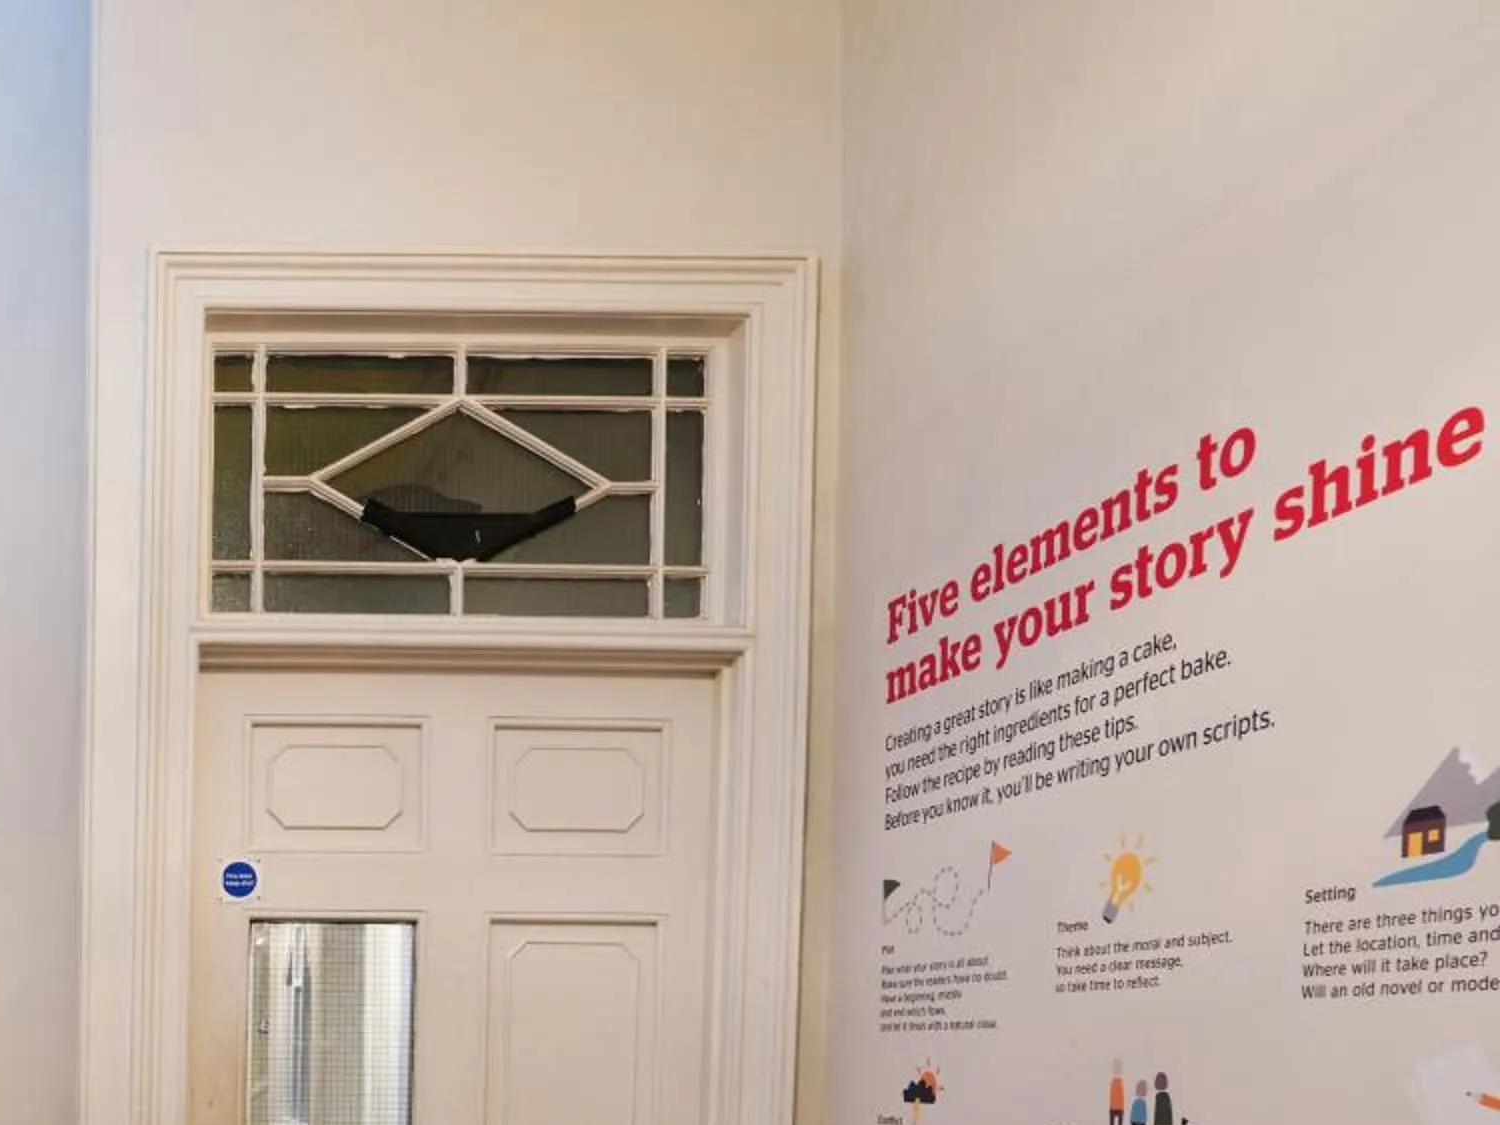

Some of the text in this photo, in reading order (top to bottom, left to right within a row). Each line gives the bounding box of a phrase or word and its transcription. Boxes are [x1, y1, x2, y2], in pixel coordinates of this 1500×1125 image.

[886, 426, 1256, 644] Five elements to
[885, 405, 1485, 704] make your story shine
[885, 633, 1177, 752] Creating a great story is like making a cake,
[885, 650, 1231, 780] you need the right ingredients for a perfect bake.
[885, 714, 1138, 804] Follow the recipe by reading these tips.
[885, 811, 920, 831] Before
[922, 804, 943, 824] you
[946, 794, 978, 813] know
[997, 774, 1033, 805] you'll
[1035, 772, 1053, 790] be
[1057, 756, 1110, 784] writing
[1115, 743, 1154, 772] your
[1158, 731, 1197, 757] own
[1203, 709, 1275, 745] scripts.
[1305, 886, 1356, 904] Setting
[1057, 921, 1089, 933] Theme
[1304, 919, 1343, 935] There
[1348, 918, 1371, 931] are
[1376, 912, 1417, 928] three
[1422, 906, 1473, 925] things
[1057, 946, 1080, 959] Think
[1083, 944, 1111, 956] about
[1113, 940, 1129, 954] the
[1164, 935, 1185, 949] and
[1187, 931, 1232, 948] subject.
[1303, 926, 1500, 956] Let the location, time and
[1055, 964, 1073, 976] You
[1074, 962, 1098, 975] need
[1100, 964, 1106, 973] a
[1108, 960, 1132, 971] clear
[1302, 951, 1488, 977] Where will it take place?
[1067, 981, 1086, 993] take
[1089, 979, 1111, 991] time
[1113, 977, 1124, 990] to
[1301, 975, 1500, 999] Will an old novel or mode
